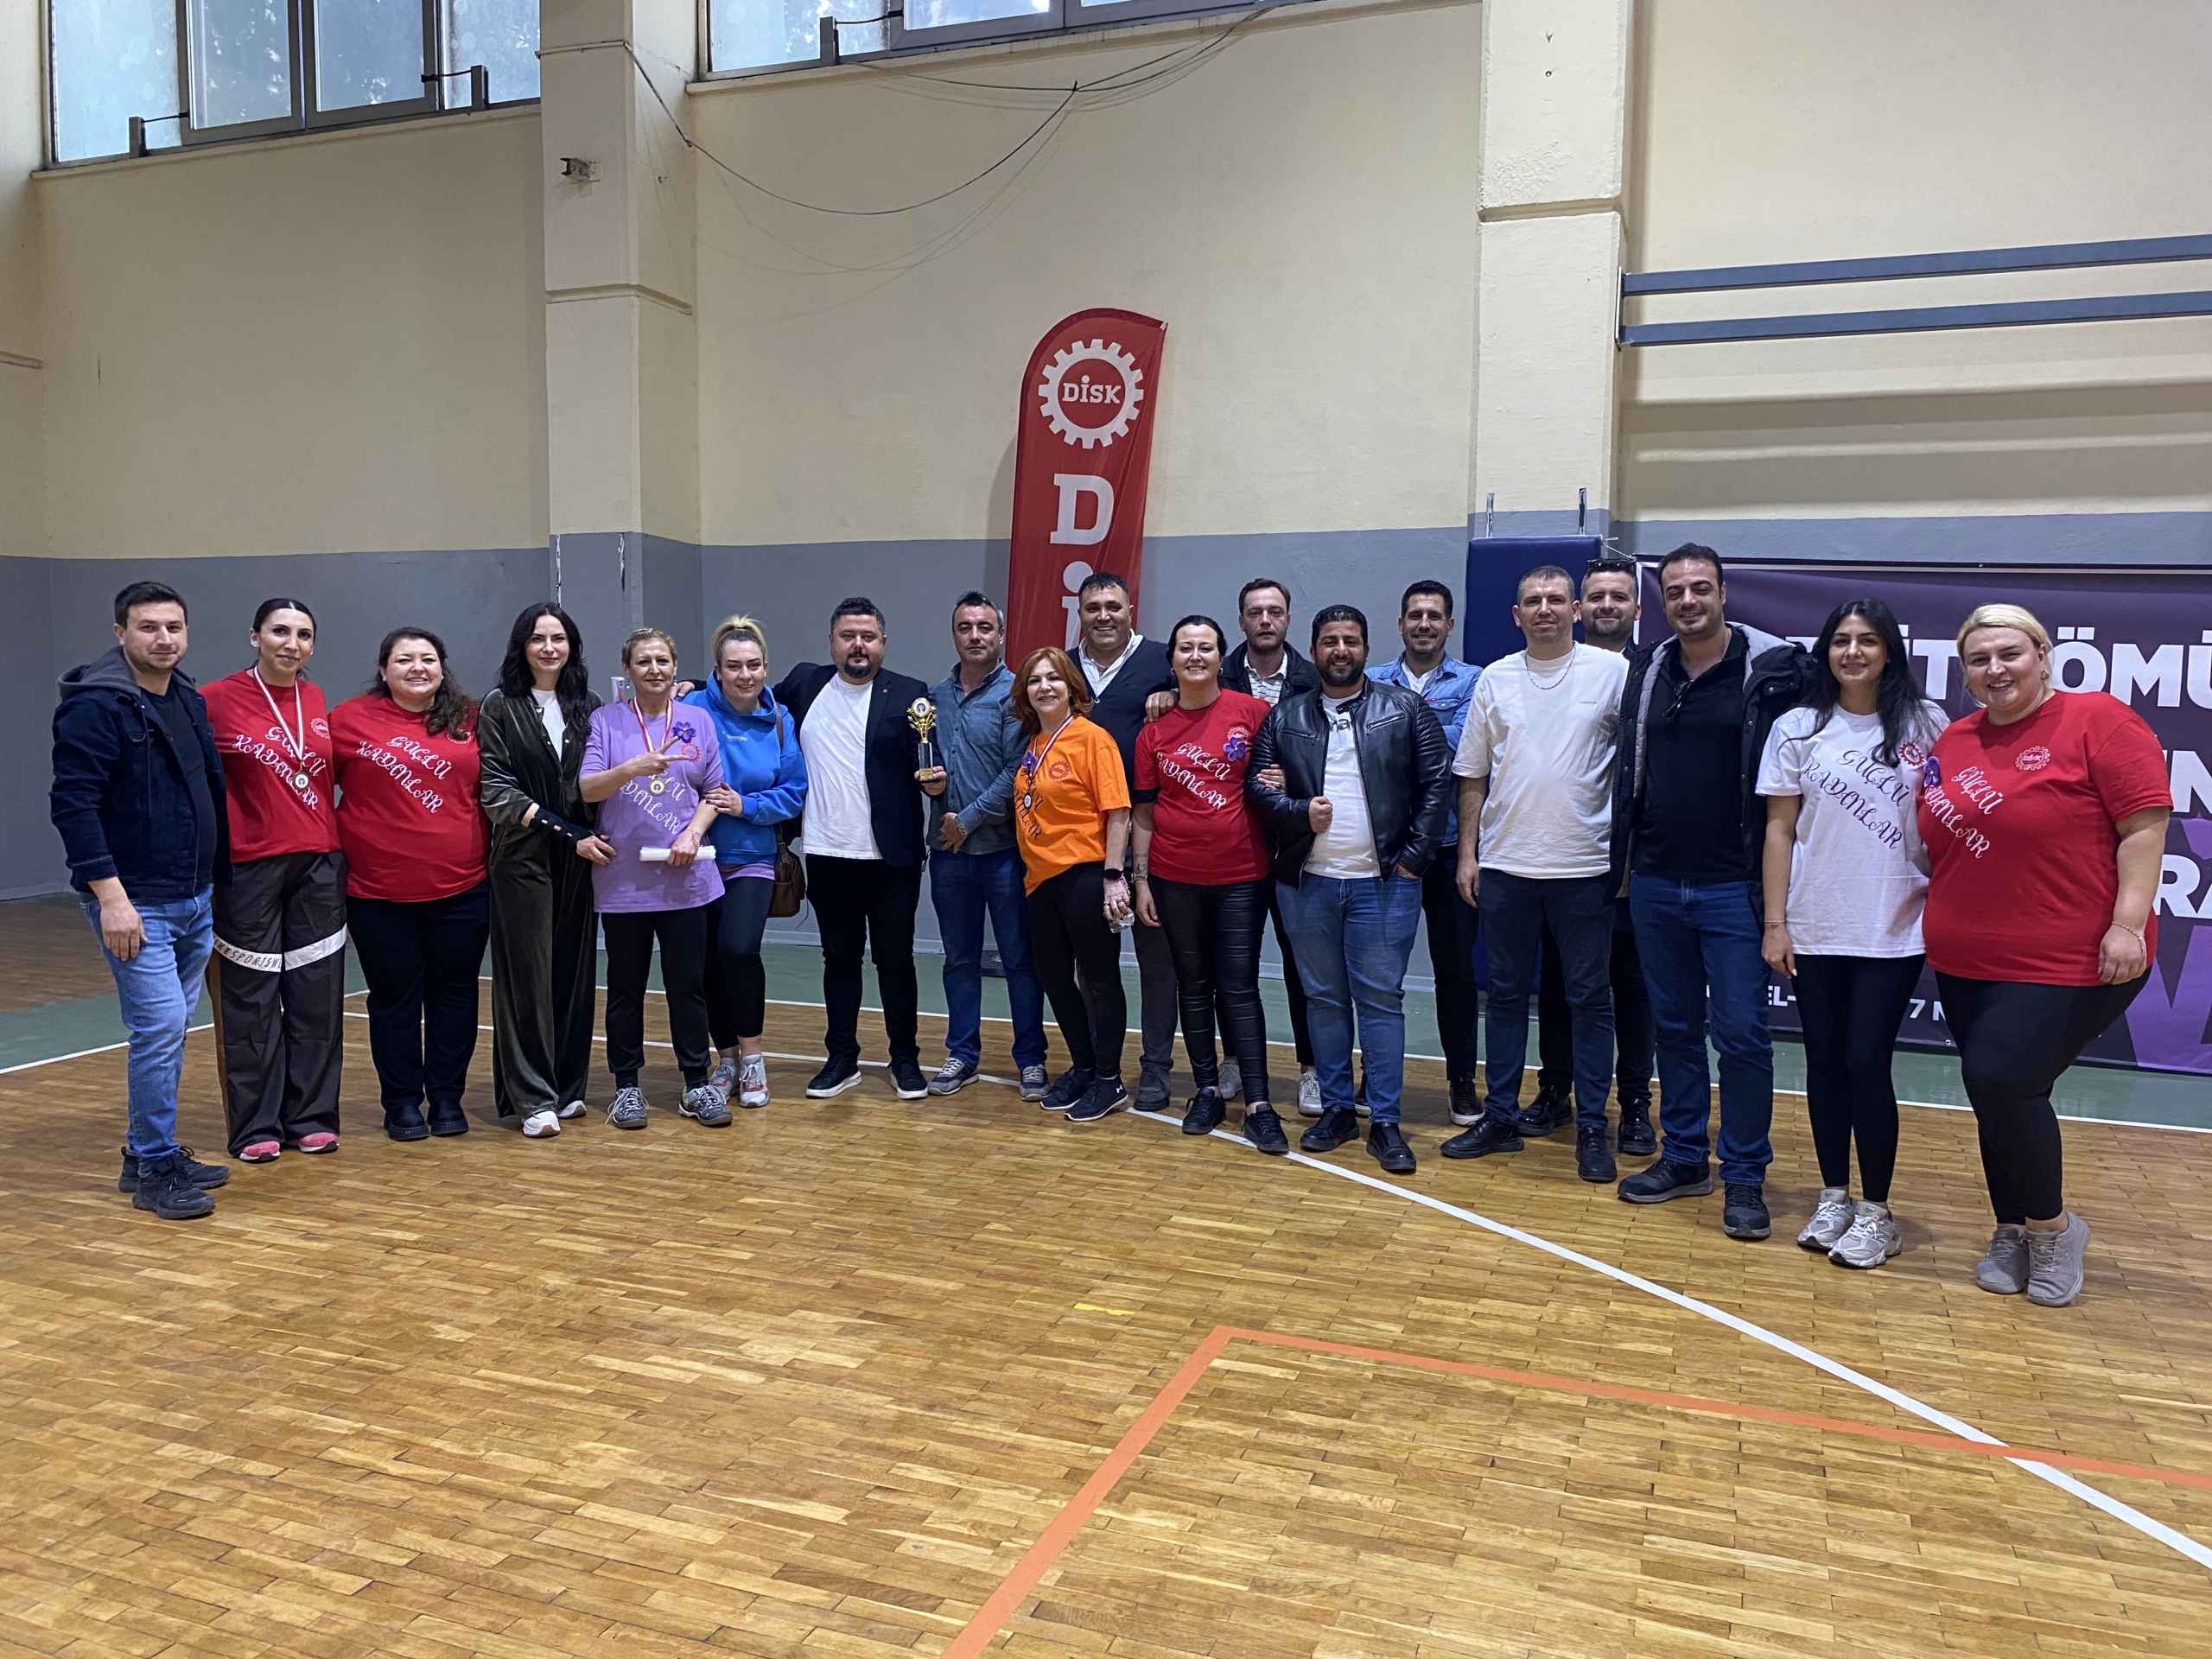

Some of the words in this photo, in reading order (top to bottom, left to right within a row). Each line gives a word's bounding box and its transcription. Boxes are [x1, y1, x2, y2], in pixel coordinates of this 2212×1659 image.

[1061, 374, 1122, 404] DİSK
[356, 741, 442, 813] KADINLAR
[386, 736, 451, 779] GÜÇLÜ
[1173, 743, 1230, 780] GÜÇLÜ
[1803, 755, 1903, 849] KADINLAR
[1951, 766, 2004, 815] GÜÇLÜ
